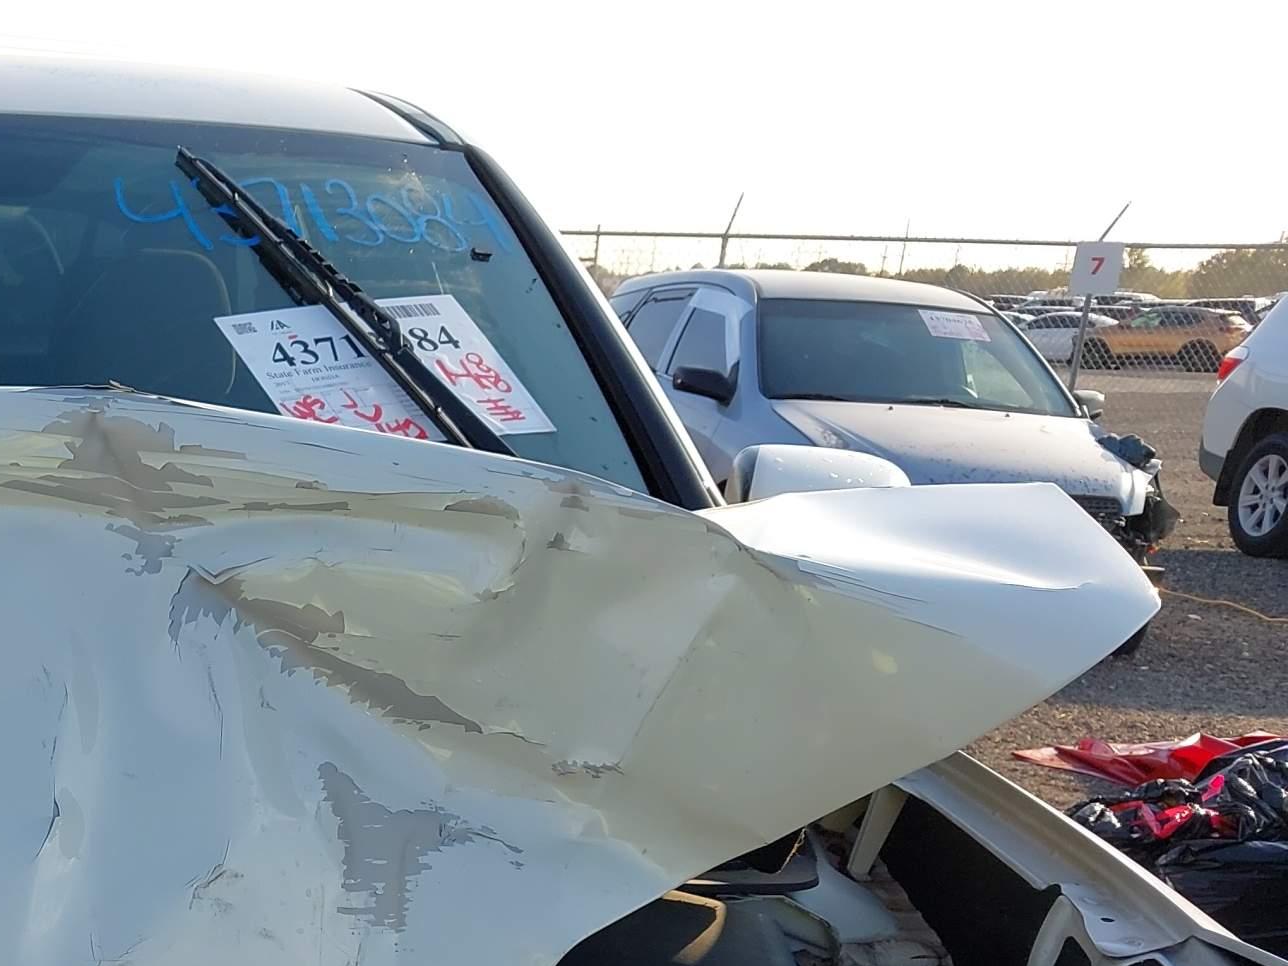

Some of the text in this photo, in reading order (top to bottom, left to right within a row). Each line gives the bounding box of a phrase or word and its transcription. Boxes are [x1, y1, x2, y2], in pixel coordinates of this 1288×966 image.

[1091, 256, 1105, 275] 7
[266, 371, 293, 379] State
[294, 367, 322, 376] Farm
